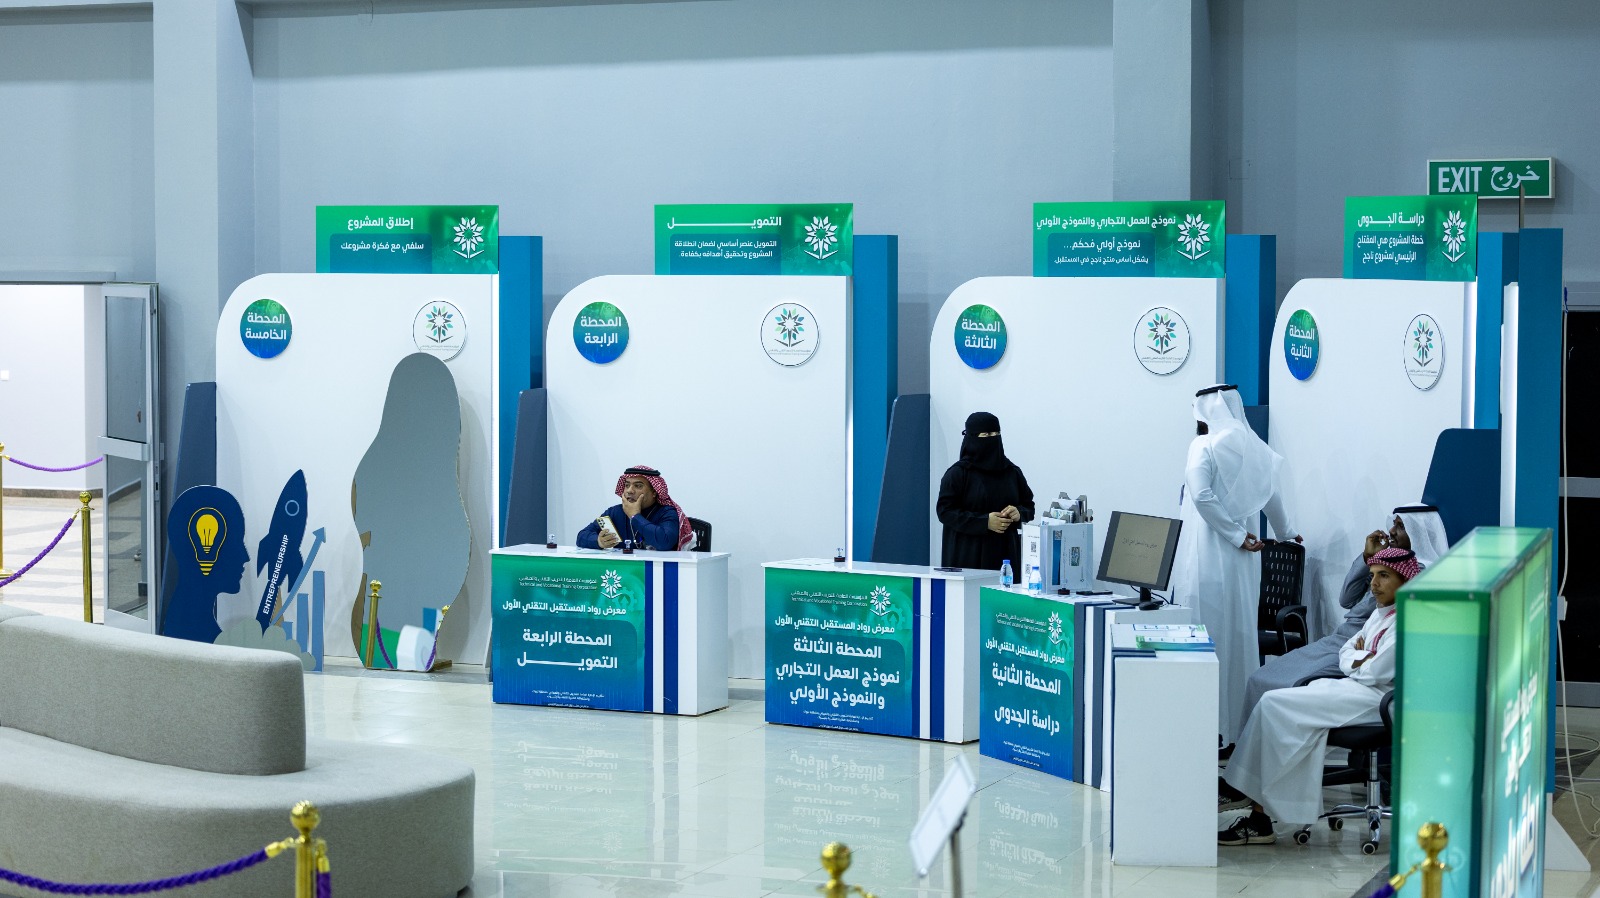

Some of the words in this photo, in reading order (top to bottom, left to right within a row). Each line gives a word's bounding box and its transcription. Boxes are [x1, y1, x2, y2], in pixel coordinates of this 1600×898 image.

[1438, 167, 1482, 193] EXIT
[1491, 165, 1540, 191] خروج
[347, 216, 384, 230] المشروع
[386, 218, 414, 229] إطلاق
[1036, 215, 1060, 229] الأولي
[1062, 217, 1095, 229] والنموذج
[1097, 217, 1125, 230] التجاري
[1127, 217, 1150, 227] العمل
[1151, 216, 1176, 229] نموذج
[341, 241, 370, 250] مشروعك
[717, 239, 739, 249] أساسي
[1097, 237, 1115, 252] أولي
[1117, 240, 1140, 251] نموذج
[1357, 235, 1376, 248] المفتاح
[1377, 238, 1388, 248] هي
[1389, 234, 1410, 248] المشروع
[1411, 235, 1424, 244] خطة
[373, 242, 389, 250] فكرة
[391, 243, 400, 252] مع
[402, 243, 424, 253] سلفي
[702, 249, 723, 257] أهدافه
[724, 251, 747, 259] وتحقيق
[749, 250, 772, 259] المشروع
[1116, 255, 1131, 263] أساس
[1363, 251, 1374, 263] ناجح
[1375, 250, 1394, 264] لمشروع
[1395, 251, 1416, 264] الرئيسي
[1080, 256, 1089, 265] في
[1090, 257, 1102, 265] ناجح
[1102, 257, 1115, 265] منتج
[247, 312, 285, 324] المحطة
[580, 316, 621, 327] المحطة
[961, 318, 1000, 332] المحطة
[245, 328, 286, 340] الخامسة
[1290, 325, 1315, 340] المحطة
[584, 333, 618, 347] الرابعة
[965, 335, 996, 349] الثالثة
[1291, 344, 1312, 360] الثانية
[263, 534, 288, 615] ENTREPRENEURSHIP
[503, 599, 520, 611] الأول
[522, 602, 548, 614] التقني
[550, 604, 585, 614] المستقبل
[588, 606, 601, 615] رواد
[603, 607, 626, 615] معرض
[775, 614, 792, 626] الأول
[794, 618, 818, 630] التقني
[820, 619, 855, 631] المستقبل
[857, 624, 870, 633] رواد
[872, 626, 895, 634] معرض
[523, 628, 562, 647] الرابعة
[565, 631, 612, 647] المحطة
[986, 637, 997, 648] الأول
[794, 636, 833, 654] الثالثة
[836, 641, 882, 659] المحطة
[998, 641, 1014, 654] التقني
[1016, 645, 1038, 657] المستقبل
[1040, 651, 1048, 662] رواد
[1049, 653, 1065, 664] معرض
[776, 661, 821, 681] التجاري
[824, 664, 859, 681] العمل
[992, 662, 1022, 686] الثانية
[862, 667, 900, 688] نموذج
[1024, 669, 1060, 695] المحطة
[790, 683, 828, 705] الأولي
[831, 688, 885, 710] والنموذج
[995, 706, 1030, 728] الجدوى
[1032, 710, 1060, 736] دراسة
